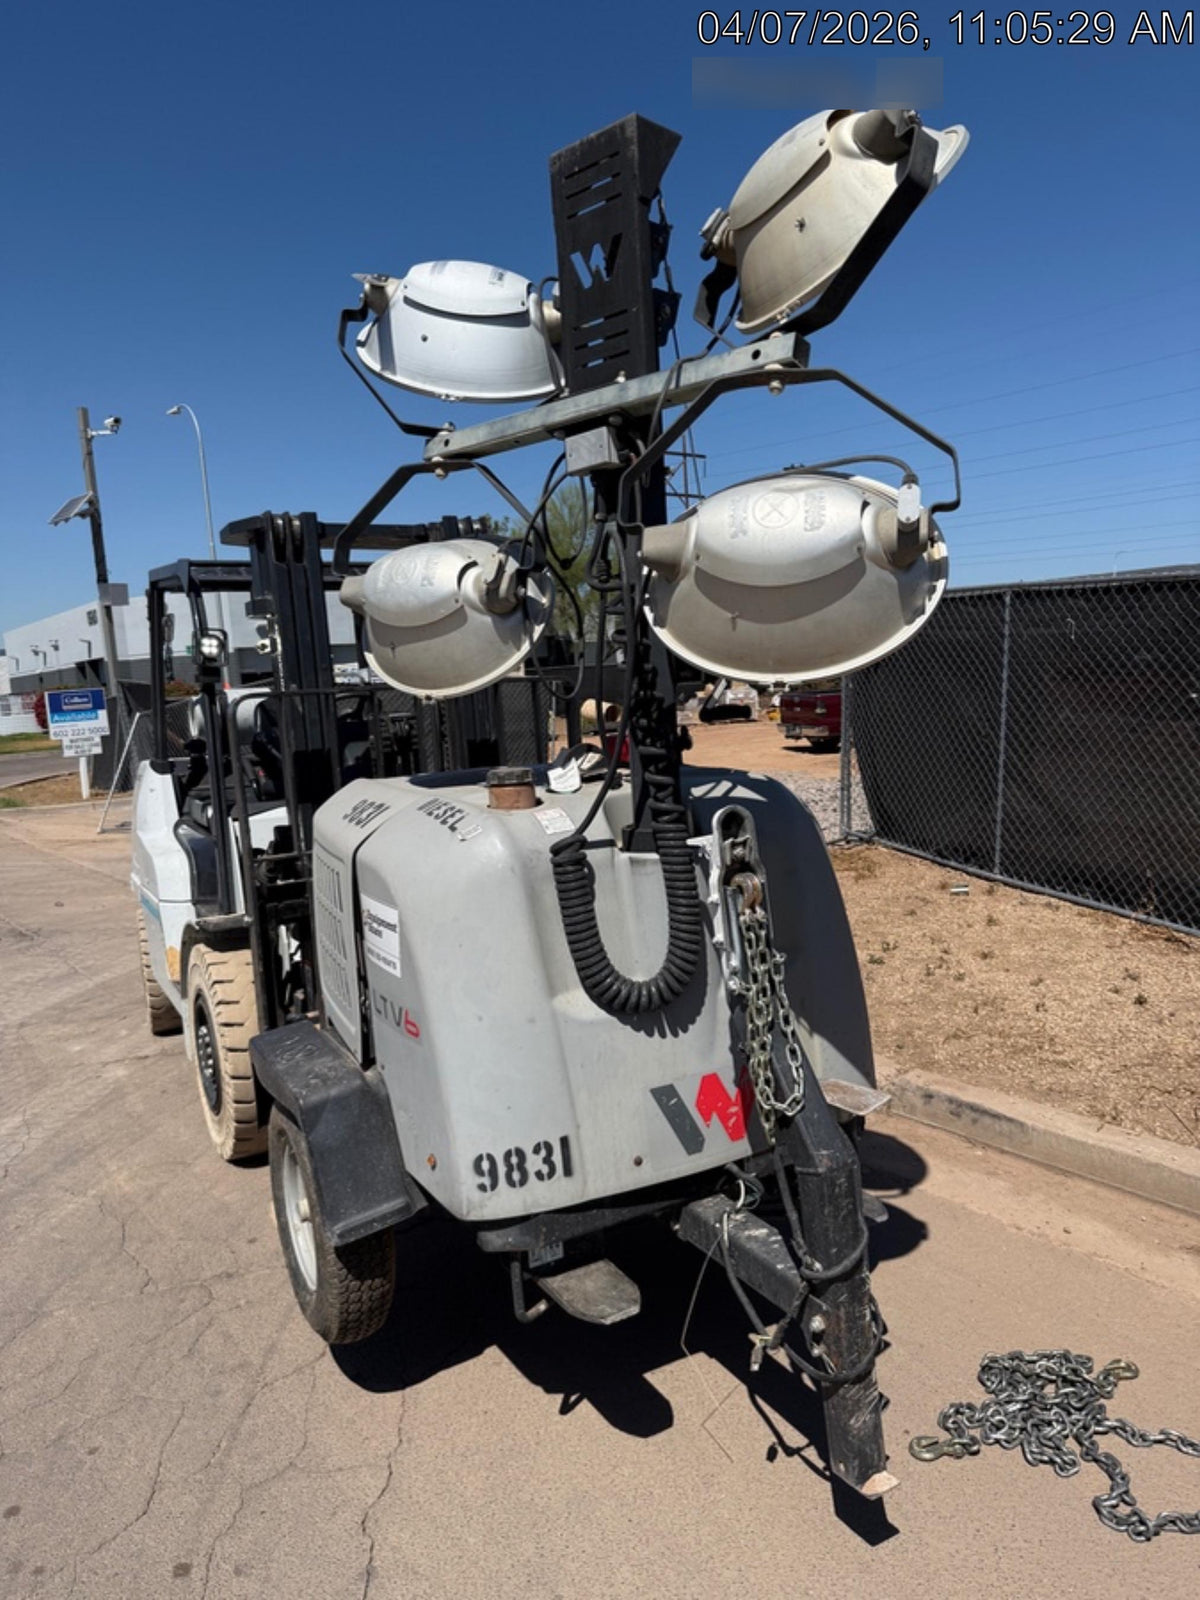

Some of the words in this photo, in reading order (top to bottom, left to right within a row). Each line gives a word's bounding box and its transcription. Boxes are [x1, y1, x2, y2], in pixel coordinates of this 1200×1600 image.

[53, 730, 69, 738] 602
[71, 728, 85, 737] 222
[416, 798, 468, 833] DIESEL
[473, 1134, 574, 1194] 9831
